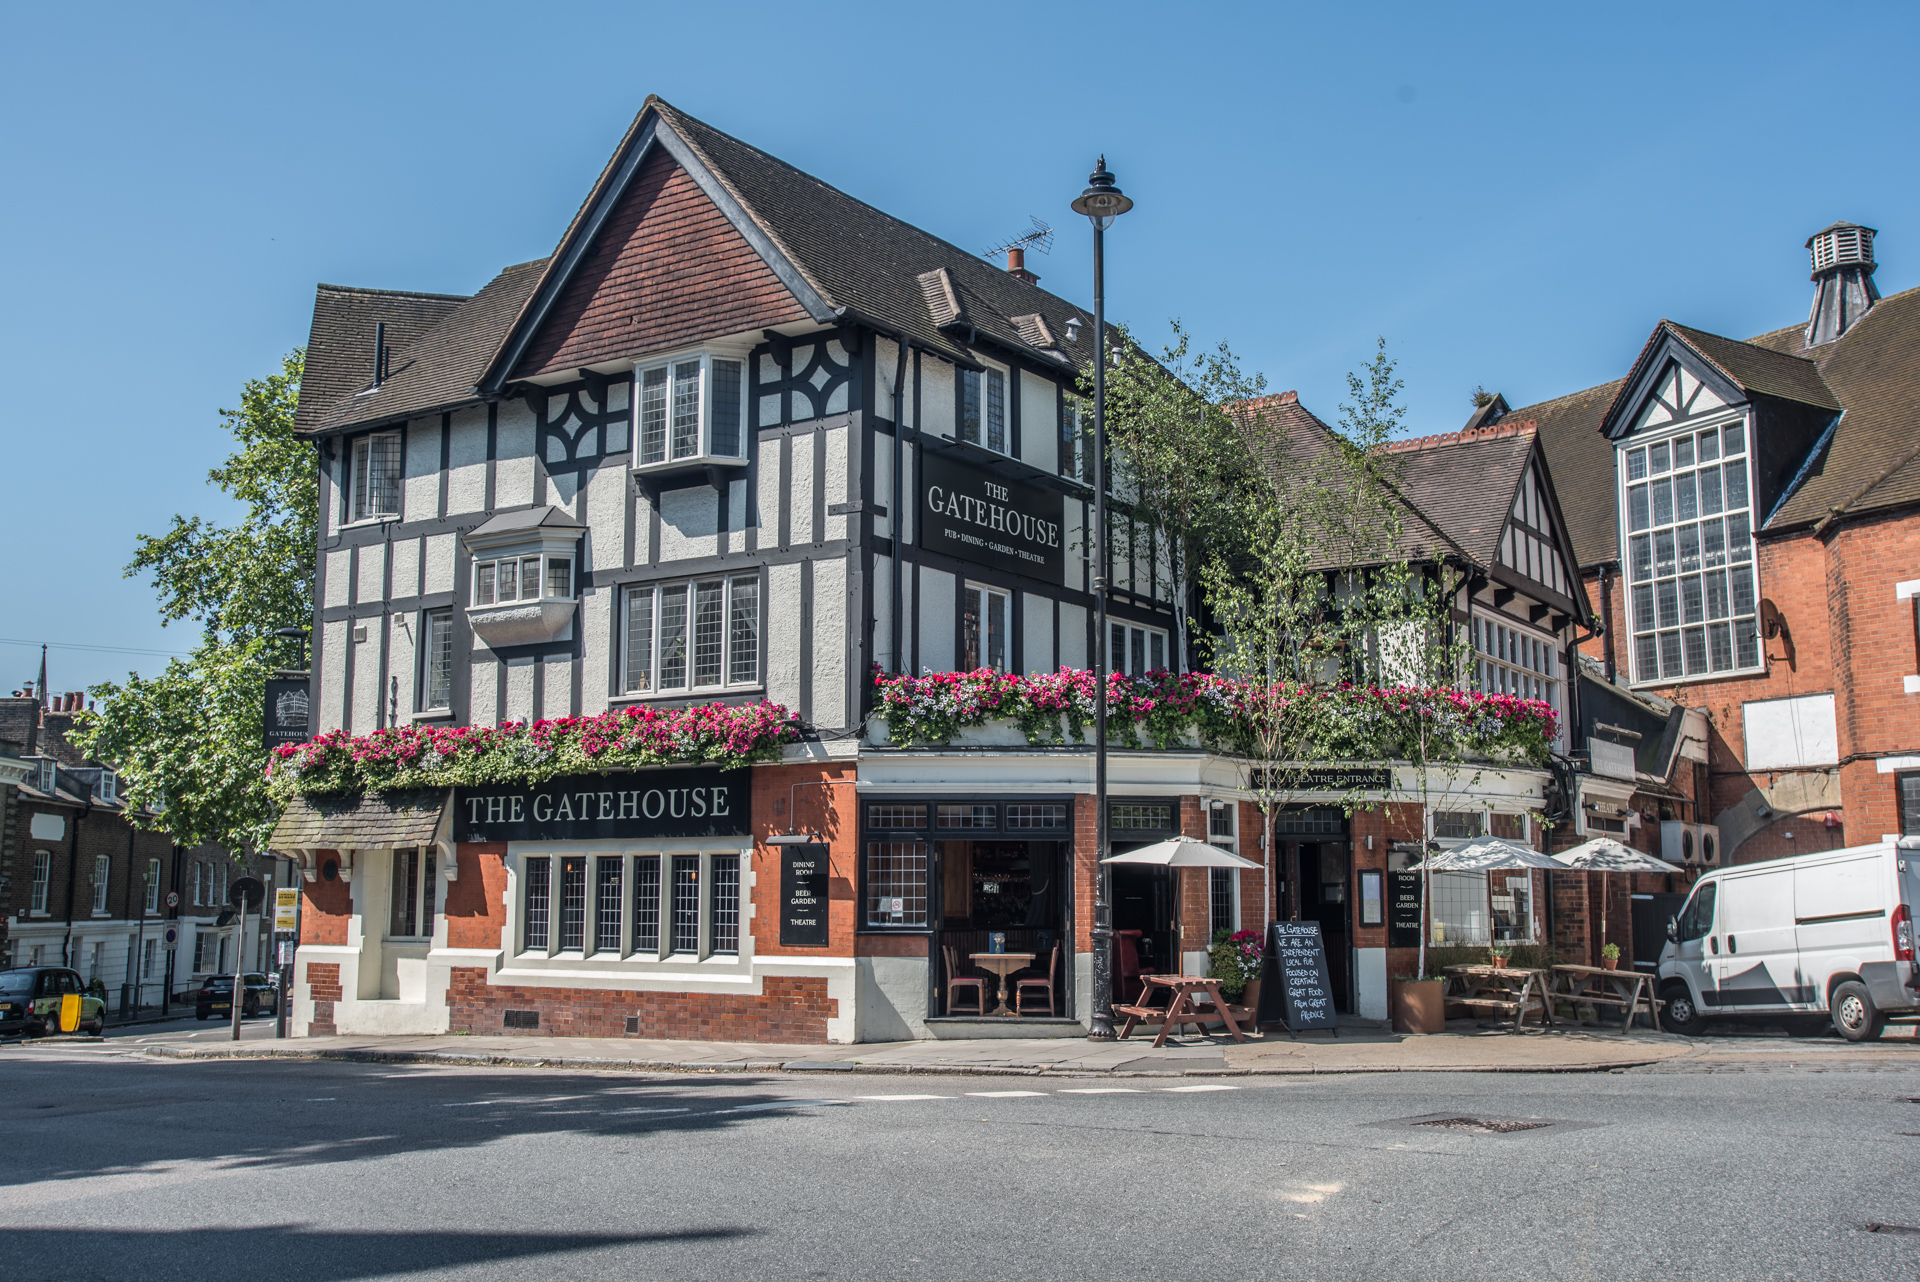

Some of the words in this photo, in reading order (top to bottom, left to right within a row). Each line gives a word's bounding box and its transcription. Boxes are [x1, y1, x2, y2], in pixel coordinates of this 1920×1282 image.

[984, 481, 1009, 502] THE
[928, 485, 1059, 548] GATEHOUSE
[944, 528, 957, 539] PUB
[961, 533, 984, 547] DINING
[988, 541, 1014, 555] GARDEN
[1017, 550, 1045, 564] THEATRE
[1592, 757, 1604, 771] THE
[1336, 775, 1387, 783] ENTRANCE
[466, 795, 525, 823] THE
[533, 787, 730, 822] GATEHOUSE
[167, 895, 178, 904] 20
[1277, 938, 1288, 947] WE
[1290, 938, 1303, 948] ARE
[1304, 938, 1314, 947] AN
[1281, 948, 1320, 957] INDEPENDENT
[1285, 958, 1302, 967] LOCAL
[1303, 956, 1315, 966] PUB
[1308, 969, 1319, 977] ON
[1289, 976, 1318, 986] CREATING
[1288, 987, 1306, 997] GREAT
[1308, 988, 1324, 997] FOOD
[1294, 999, 1308, 1009] FROM
[1308, 998, 1327, 1009] GREAT
[1300, 1010, 1326, 1023] PRODUCE
